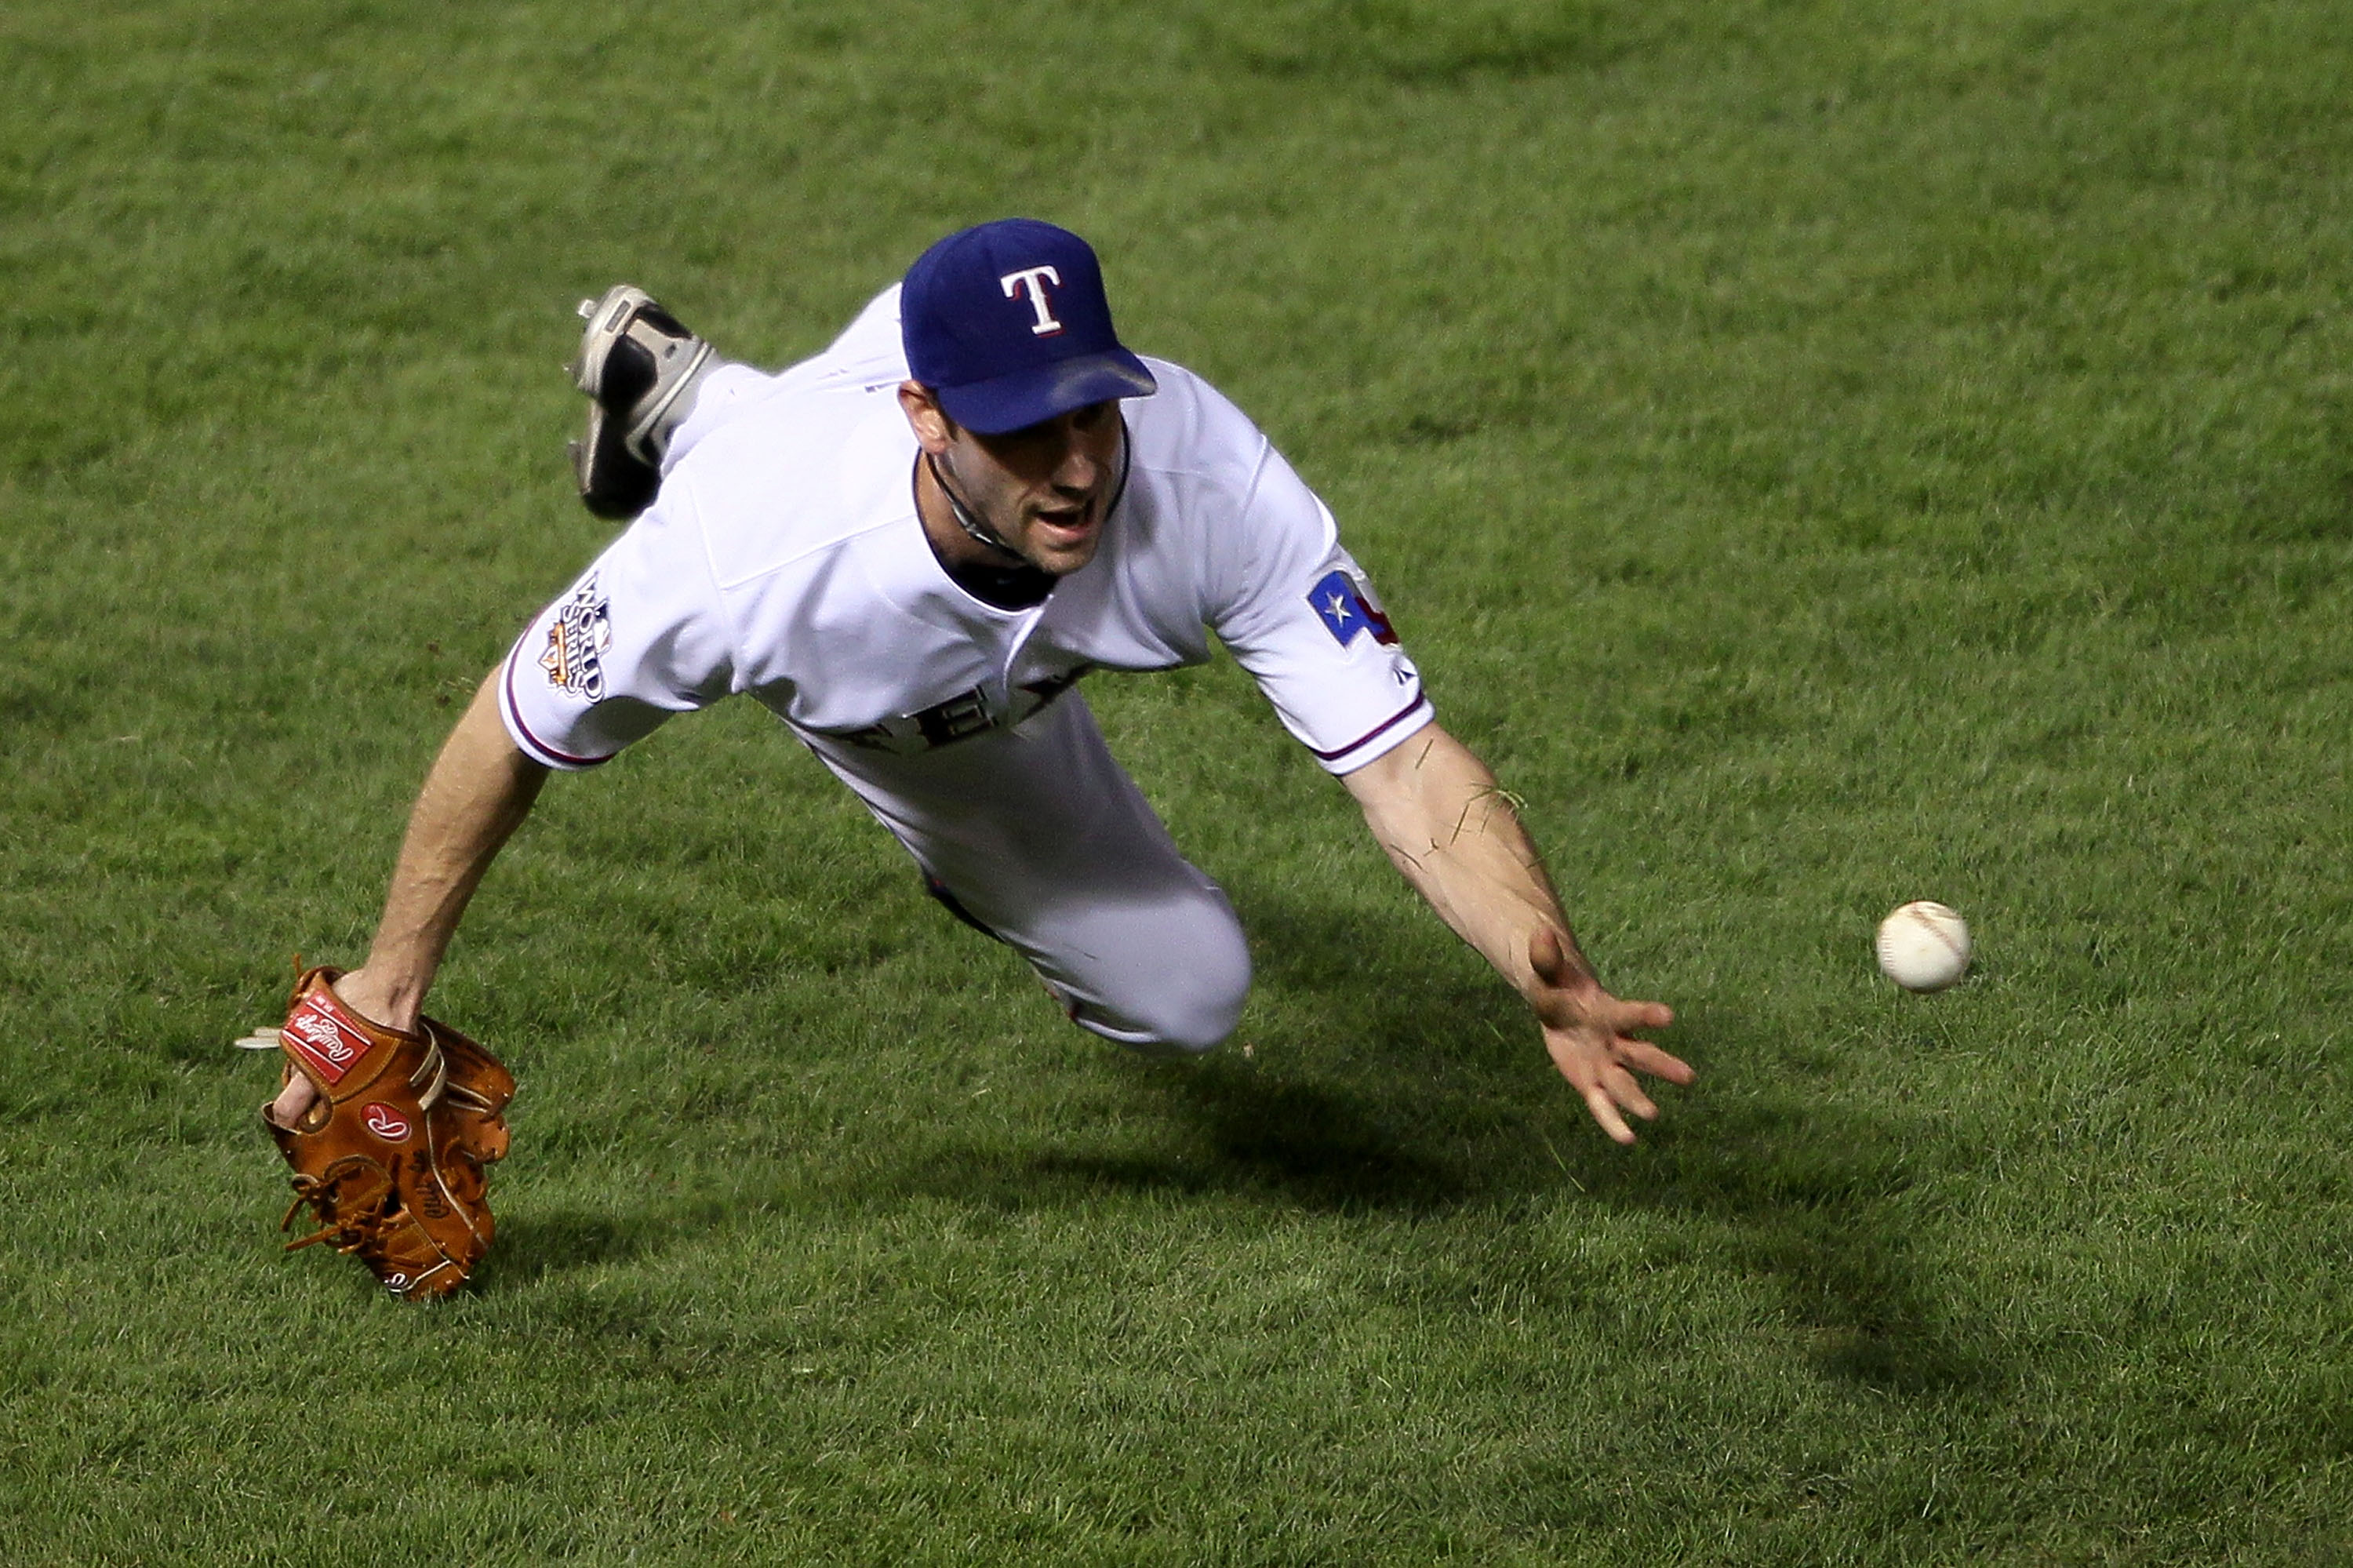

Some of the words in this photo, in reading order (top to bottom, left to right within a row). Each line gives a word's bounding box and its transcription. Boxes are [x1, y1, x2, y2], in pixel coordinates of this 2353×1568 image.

[1000, 265, 1064, 336] T
[562, 600, 585, 693] SERIES
[577, 571, 604, 699] WORLD
[294, 1013, 355, 1062] Rawlings
